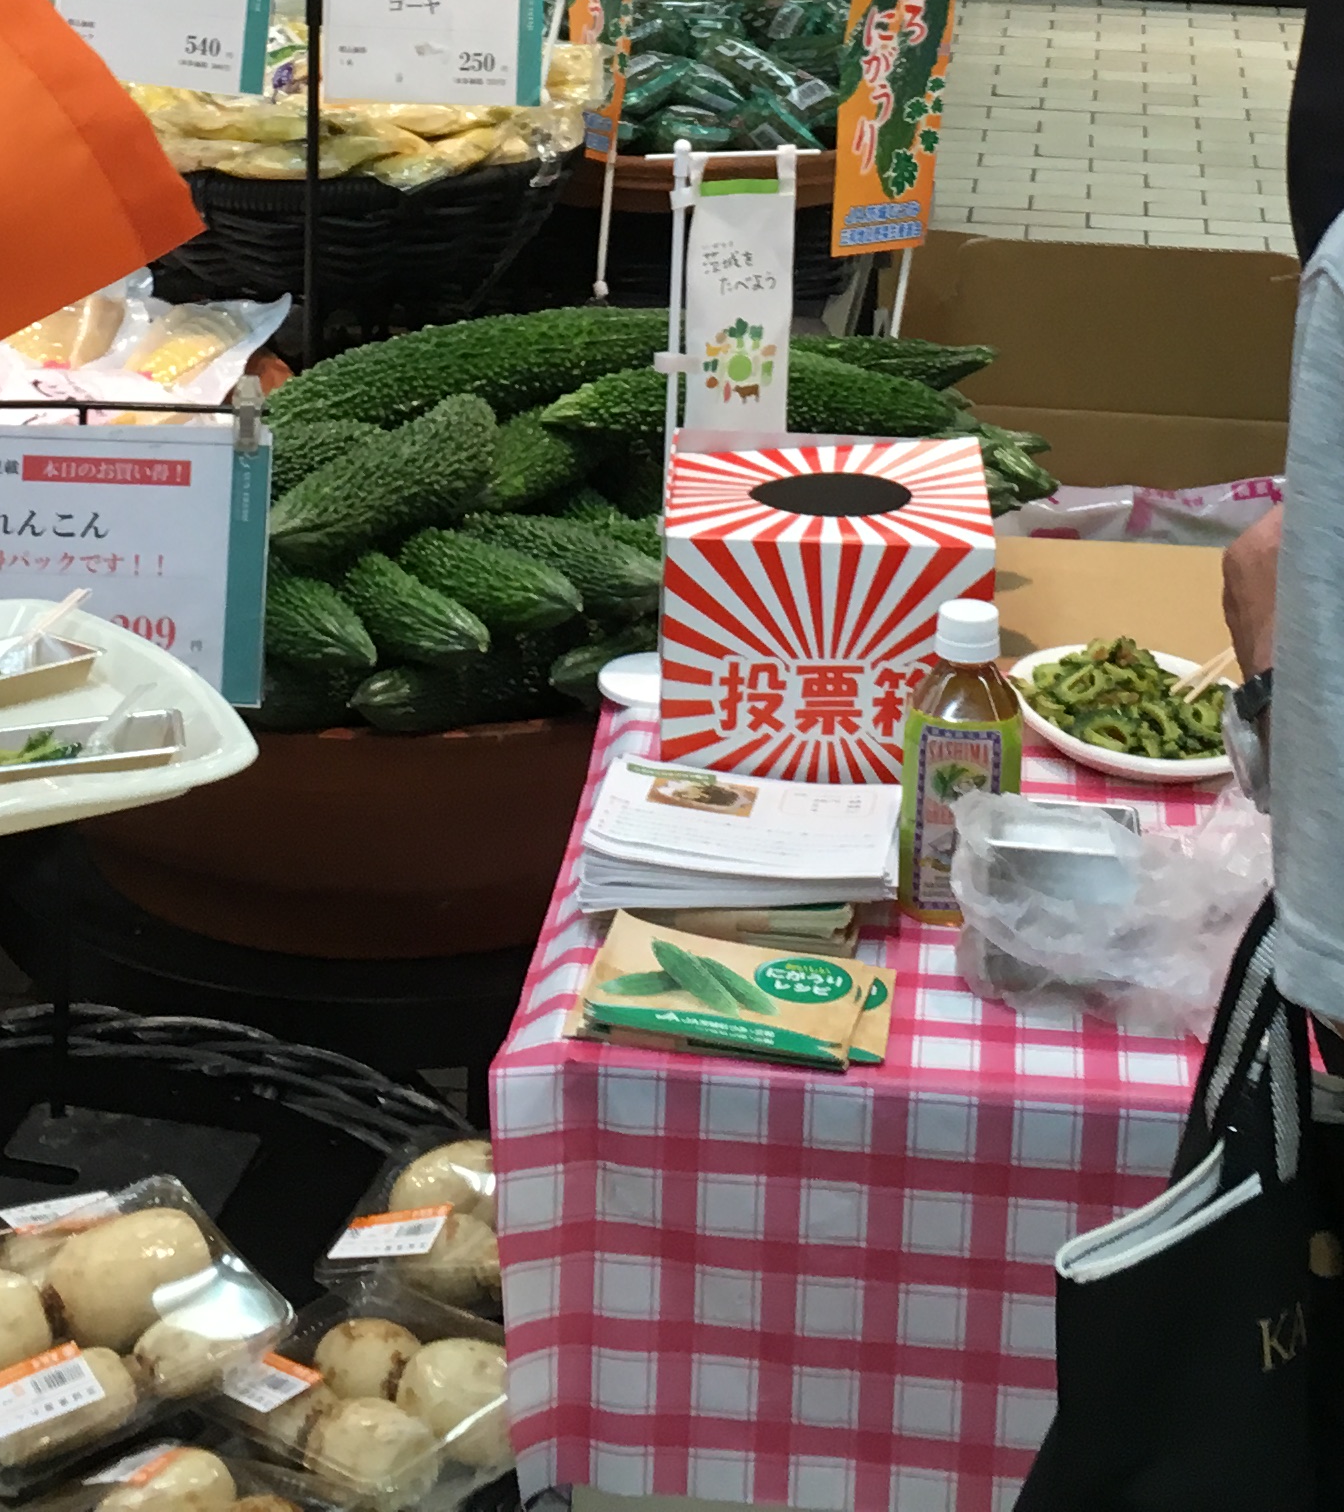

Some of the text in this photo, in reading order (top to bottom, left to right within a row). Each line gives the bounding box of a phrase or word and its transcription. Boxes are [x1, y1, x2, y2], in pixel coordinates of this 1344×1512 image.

[184, 34, 222, 58] 540
[458, 51, 496, 73] 250
[854, 9, 895, 176] にがうり
